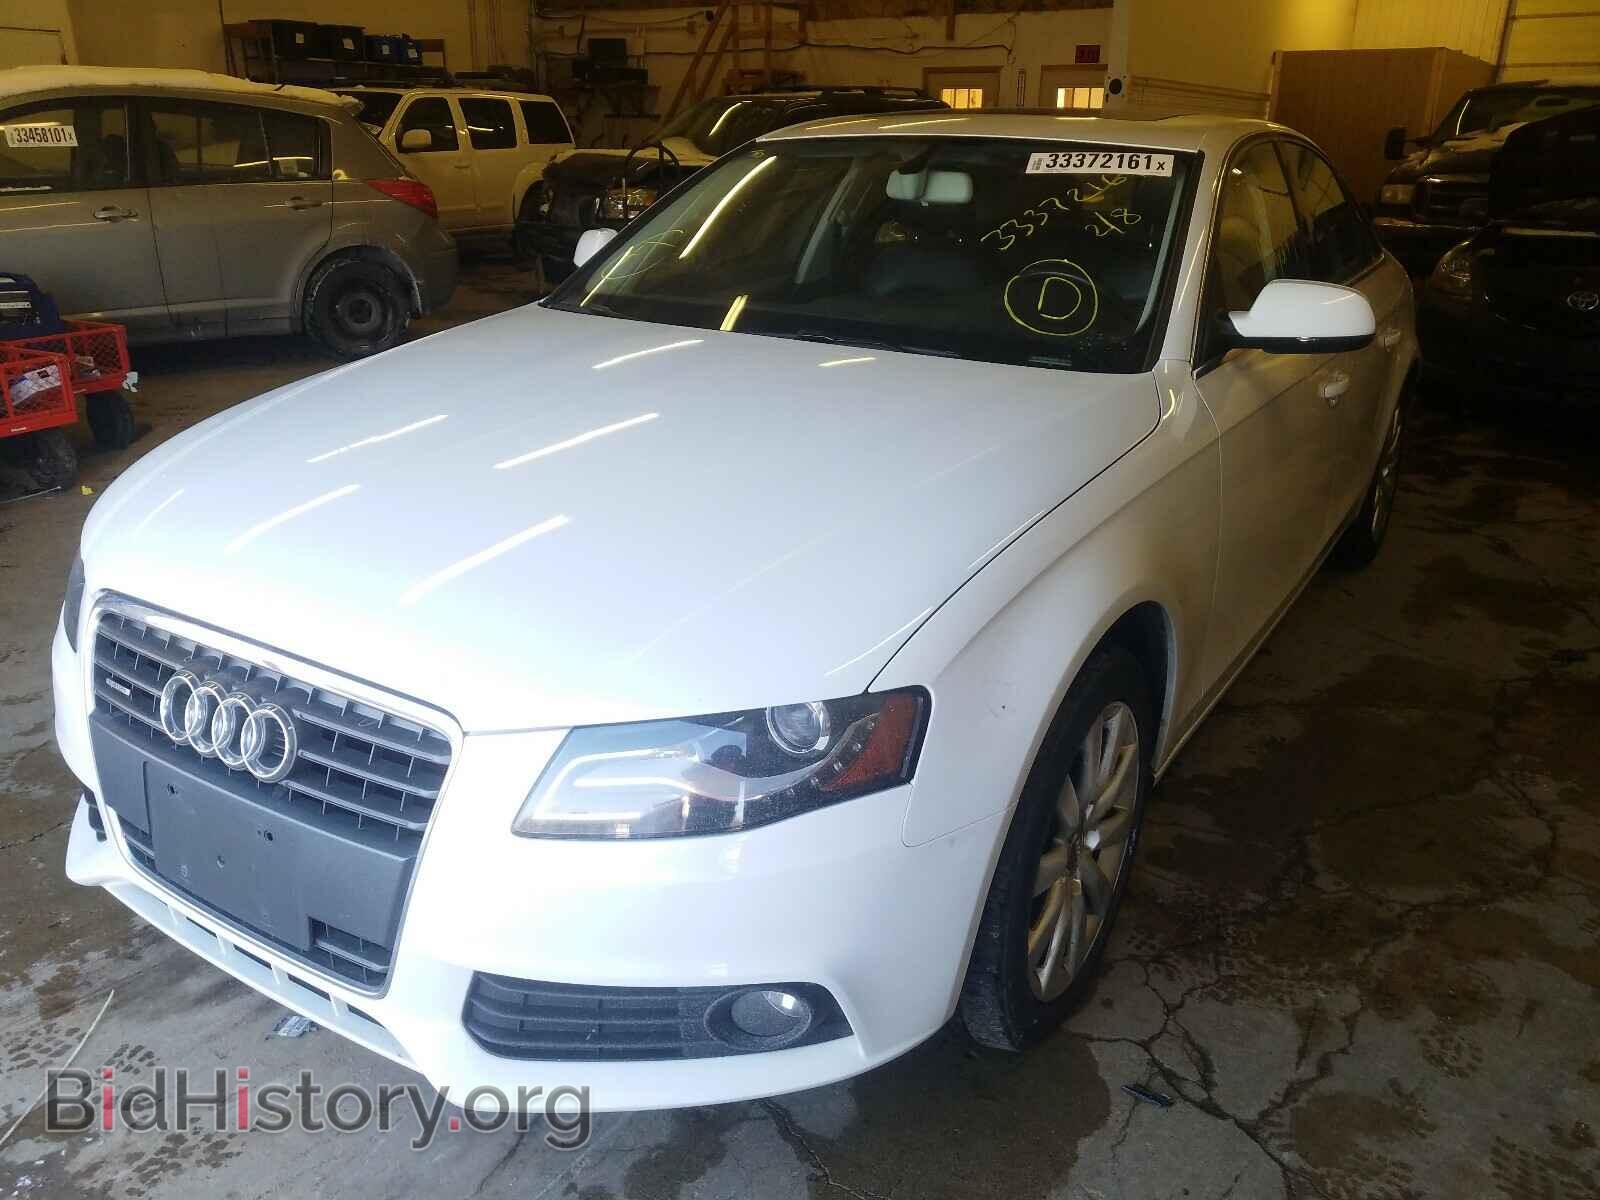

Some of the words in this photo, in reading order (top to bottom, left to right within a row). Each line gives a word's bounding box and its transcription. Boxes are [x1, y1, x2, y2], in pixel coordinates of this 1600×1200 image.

[14, 128, 67, 143] 33458101
[1046, 153, 1153, 170] 33372161
[1037, 276, 1082, 320] D
